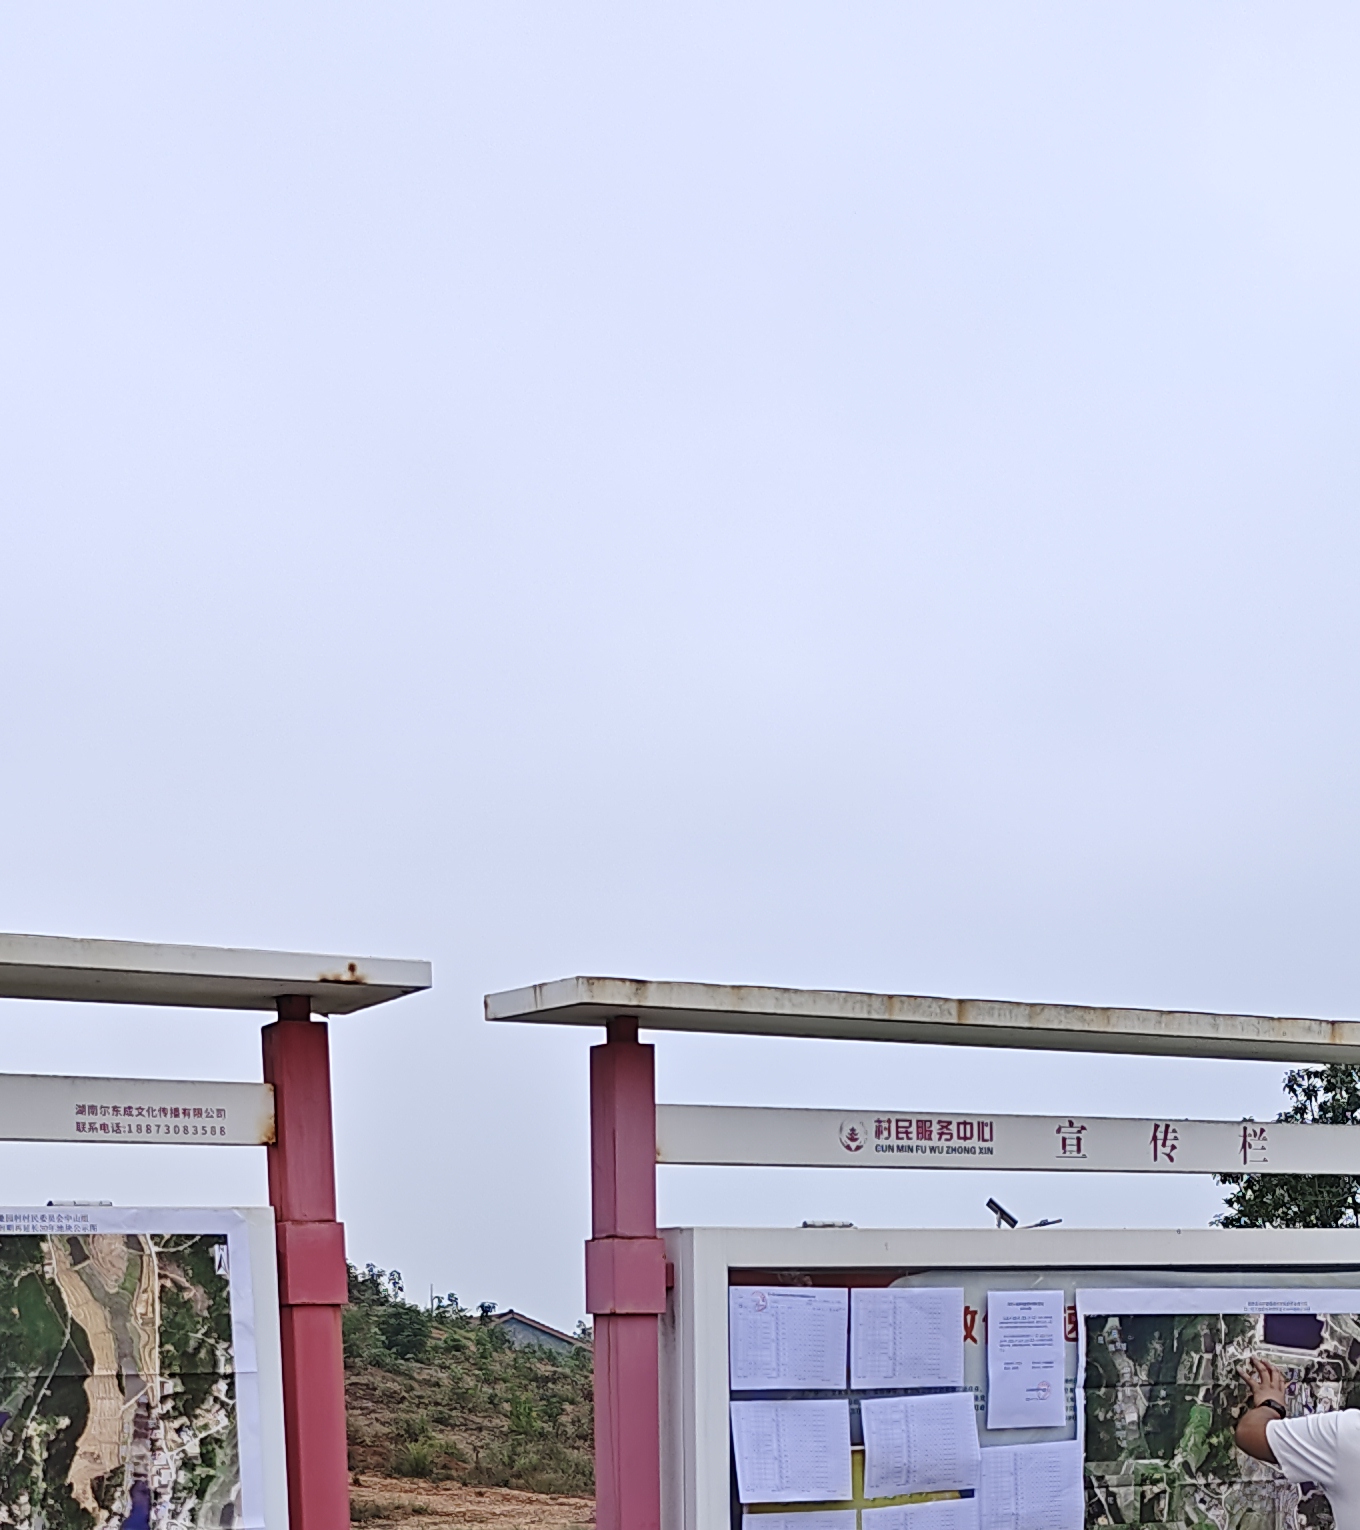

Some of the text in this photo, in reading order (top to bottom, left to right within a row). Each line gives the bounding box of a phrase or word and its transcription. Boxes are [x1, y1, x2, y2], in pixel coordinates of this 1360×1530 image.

[75, 1103, 226, 1120] 湖南尔东成文化传播有限公司
[874, 1117, 993, 1142] 村民服务中心
[875, 1143, 994, 1155] CUN MIN FU WU ZHONG XIN
